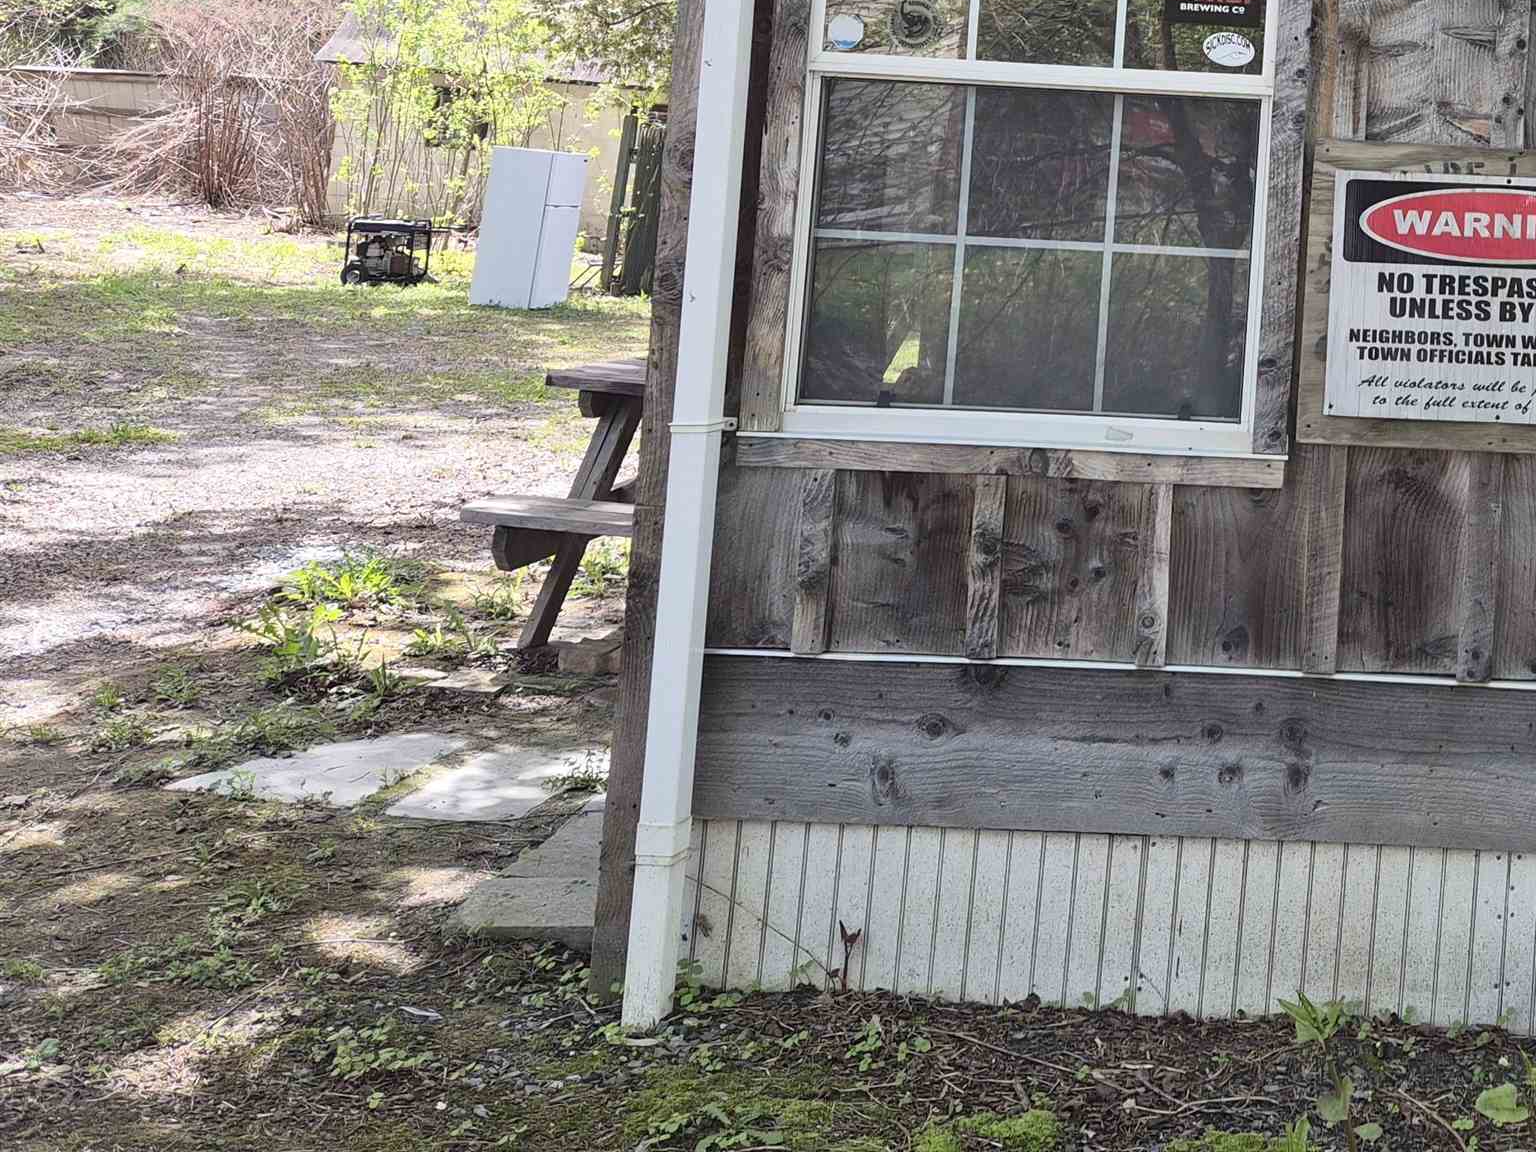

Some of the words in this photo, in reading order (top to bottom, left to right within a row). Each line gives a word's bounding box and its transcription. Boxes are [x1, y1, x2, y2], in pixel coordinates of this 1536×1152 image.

[1180, 2, 1230, 14] BREWING
[1377, 272, 1415, 294] NO
[1389, 296, 1492, 322] UNLESS
[1499, 301, 1534, 323] BY
[1349, 328, 1457, 348] NEIGHBORS,
[1463, 333, 1517, 349] TOWN
[1356, 346, 1411, 363] TOWN
[1416, 348, 1506, 366] OFFICIALS
[1358, 374, 1388, 388] All
[1393, 377, 1465, 392] violators
[1472, 380, 1505, 393] will
[1511, 380, 1527, 394] be
[1372, 394, 1387, 406] to
[1394, 394, 1418, 407] the
[1423, 396, 1457, 411] full
[1461, 398, 1509, 411] extent
[1514, 399, 1532, 415] of
